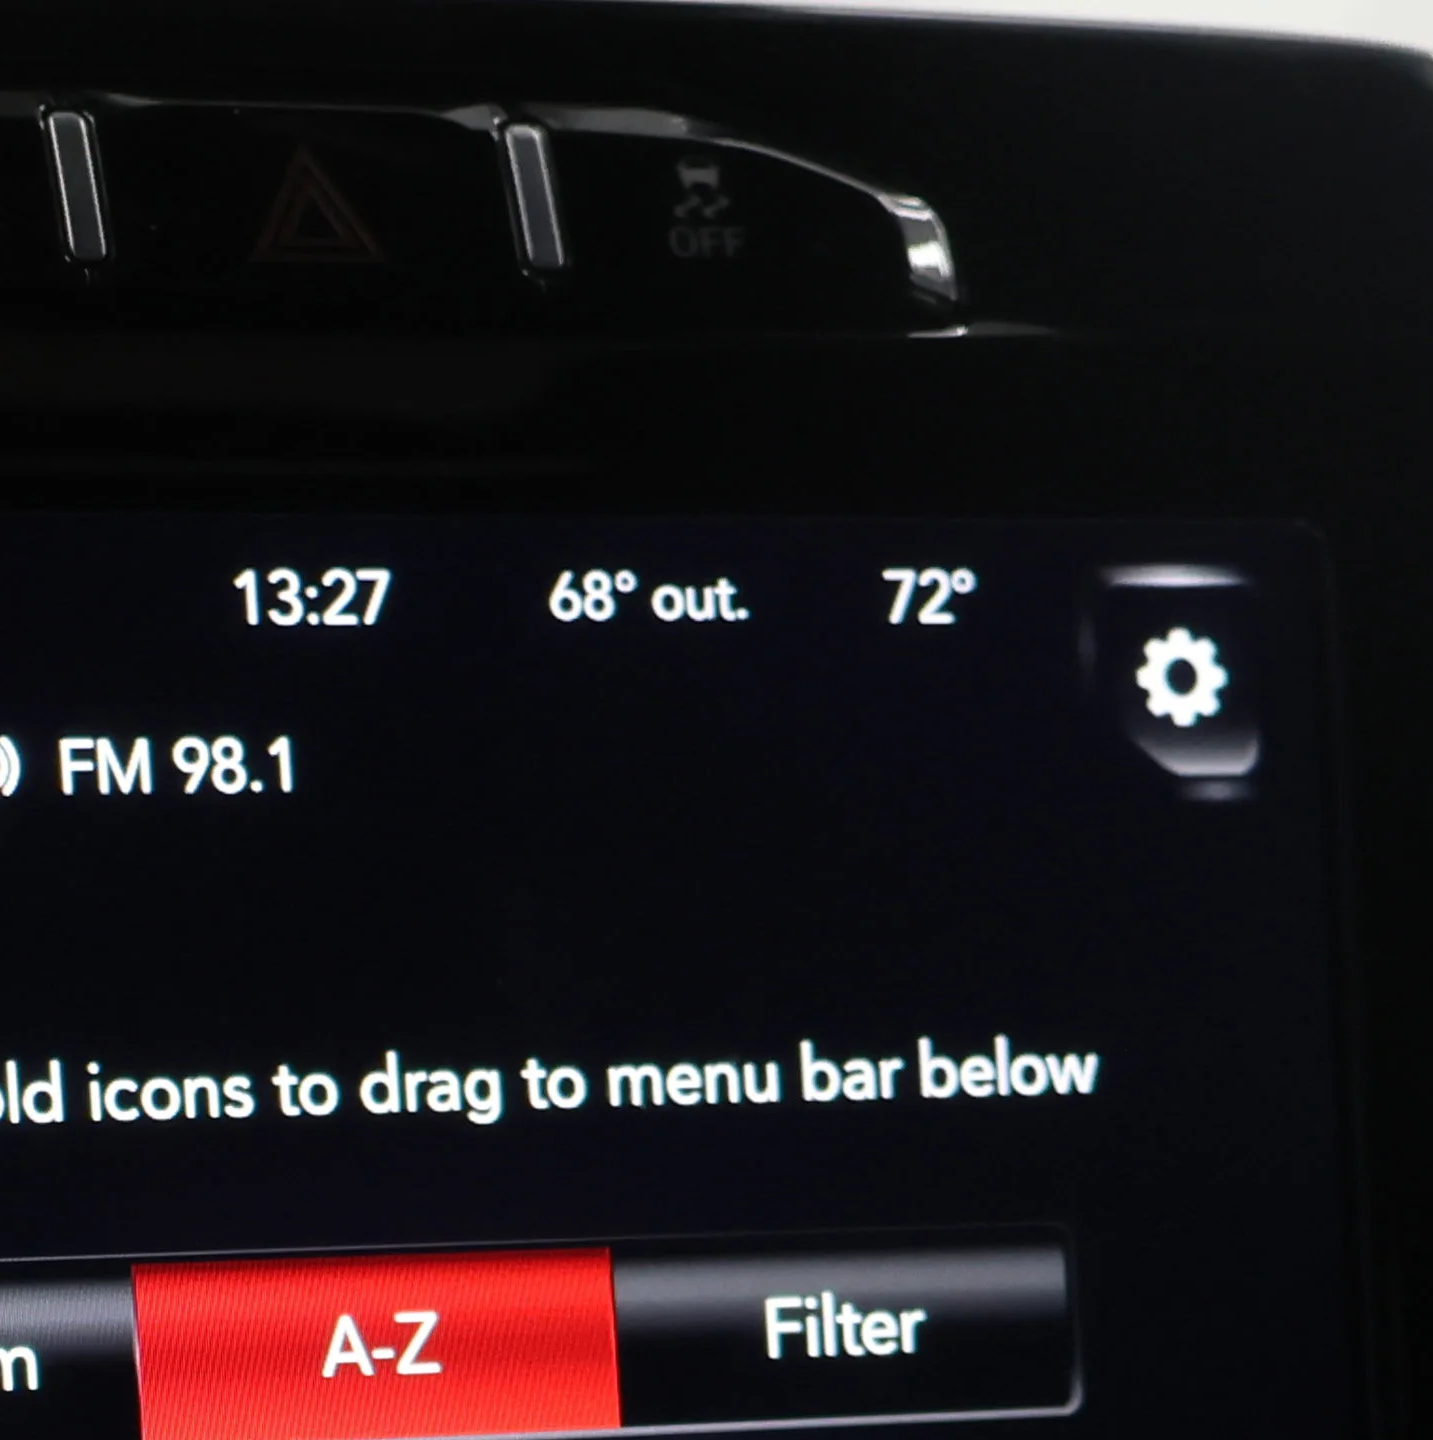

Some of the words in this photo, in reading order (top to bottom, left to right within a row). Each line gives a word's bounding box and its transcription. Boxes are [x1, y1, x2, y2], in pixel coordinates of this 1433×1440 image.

[669, 222, 745, 260] OFF
[233, 567, 392, 627] 13:27
[548, 569, 638, 622] 68°
[650, 577, 750, 622] out.
[881, 567, 977, 625] 72°
[58, 736, 153, 796] FM
[171, 735, 294, 795] 98.1
[86, 1061, 256, 1122] icons
[271, 1064, 341, 1117] to
[359, 1049, 504, 1125] drag
[519, 1057, 588, 1110] to
[606, 1061, 781, 1107] menu
[799, 1039, 905, 1102] bar
[917, 1034, 1100, 1099] below
[321, 1309, 443, 1378] A-Z
[762, 1291, 926, 1362] Filter
